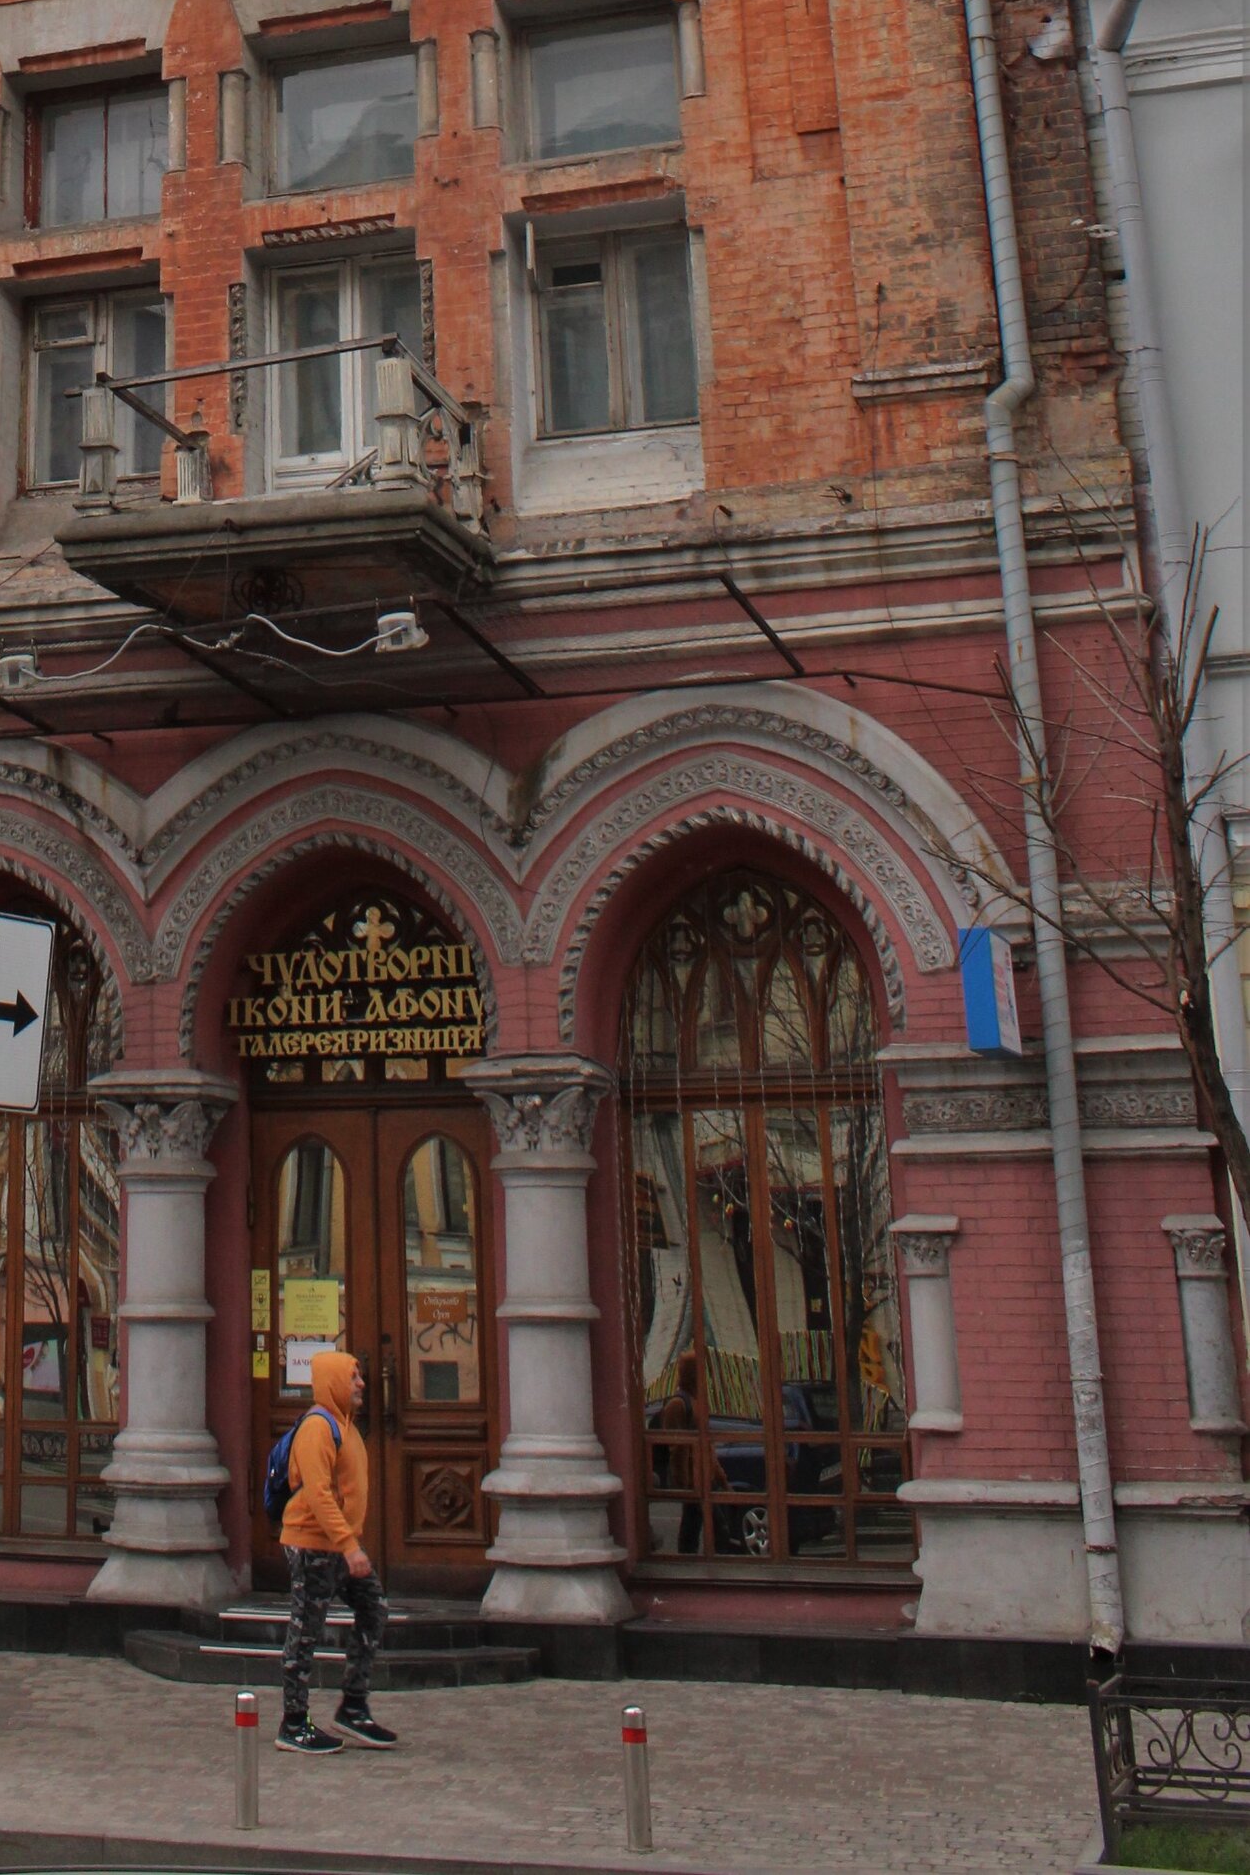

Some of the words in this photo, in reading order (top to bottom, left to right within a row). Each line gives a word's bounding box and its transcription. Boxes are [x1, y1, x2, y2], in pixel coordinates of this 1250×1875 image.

[247, 944, 474, 993] ЧУДОТВОРНІ
[228, 990, 344, 1027] ІКОНИ
[365, 987, 484, 1026] АФОНУ
[432, 1309, 450, 1320] Open
